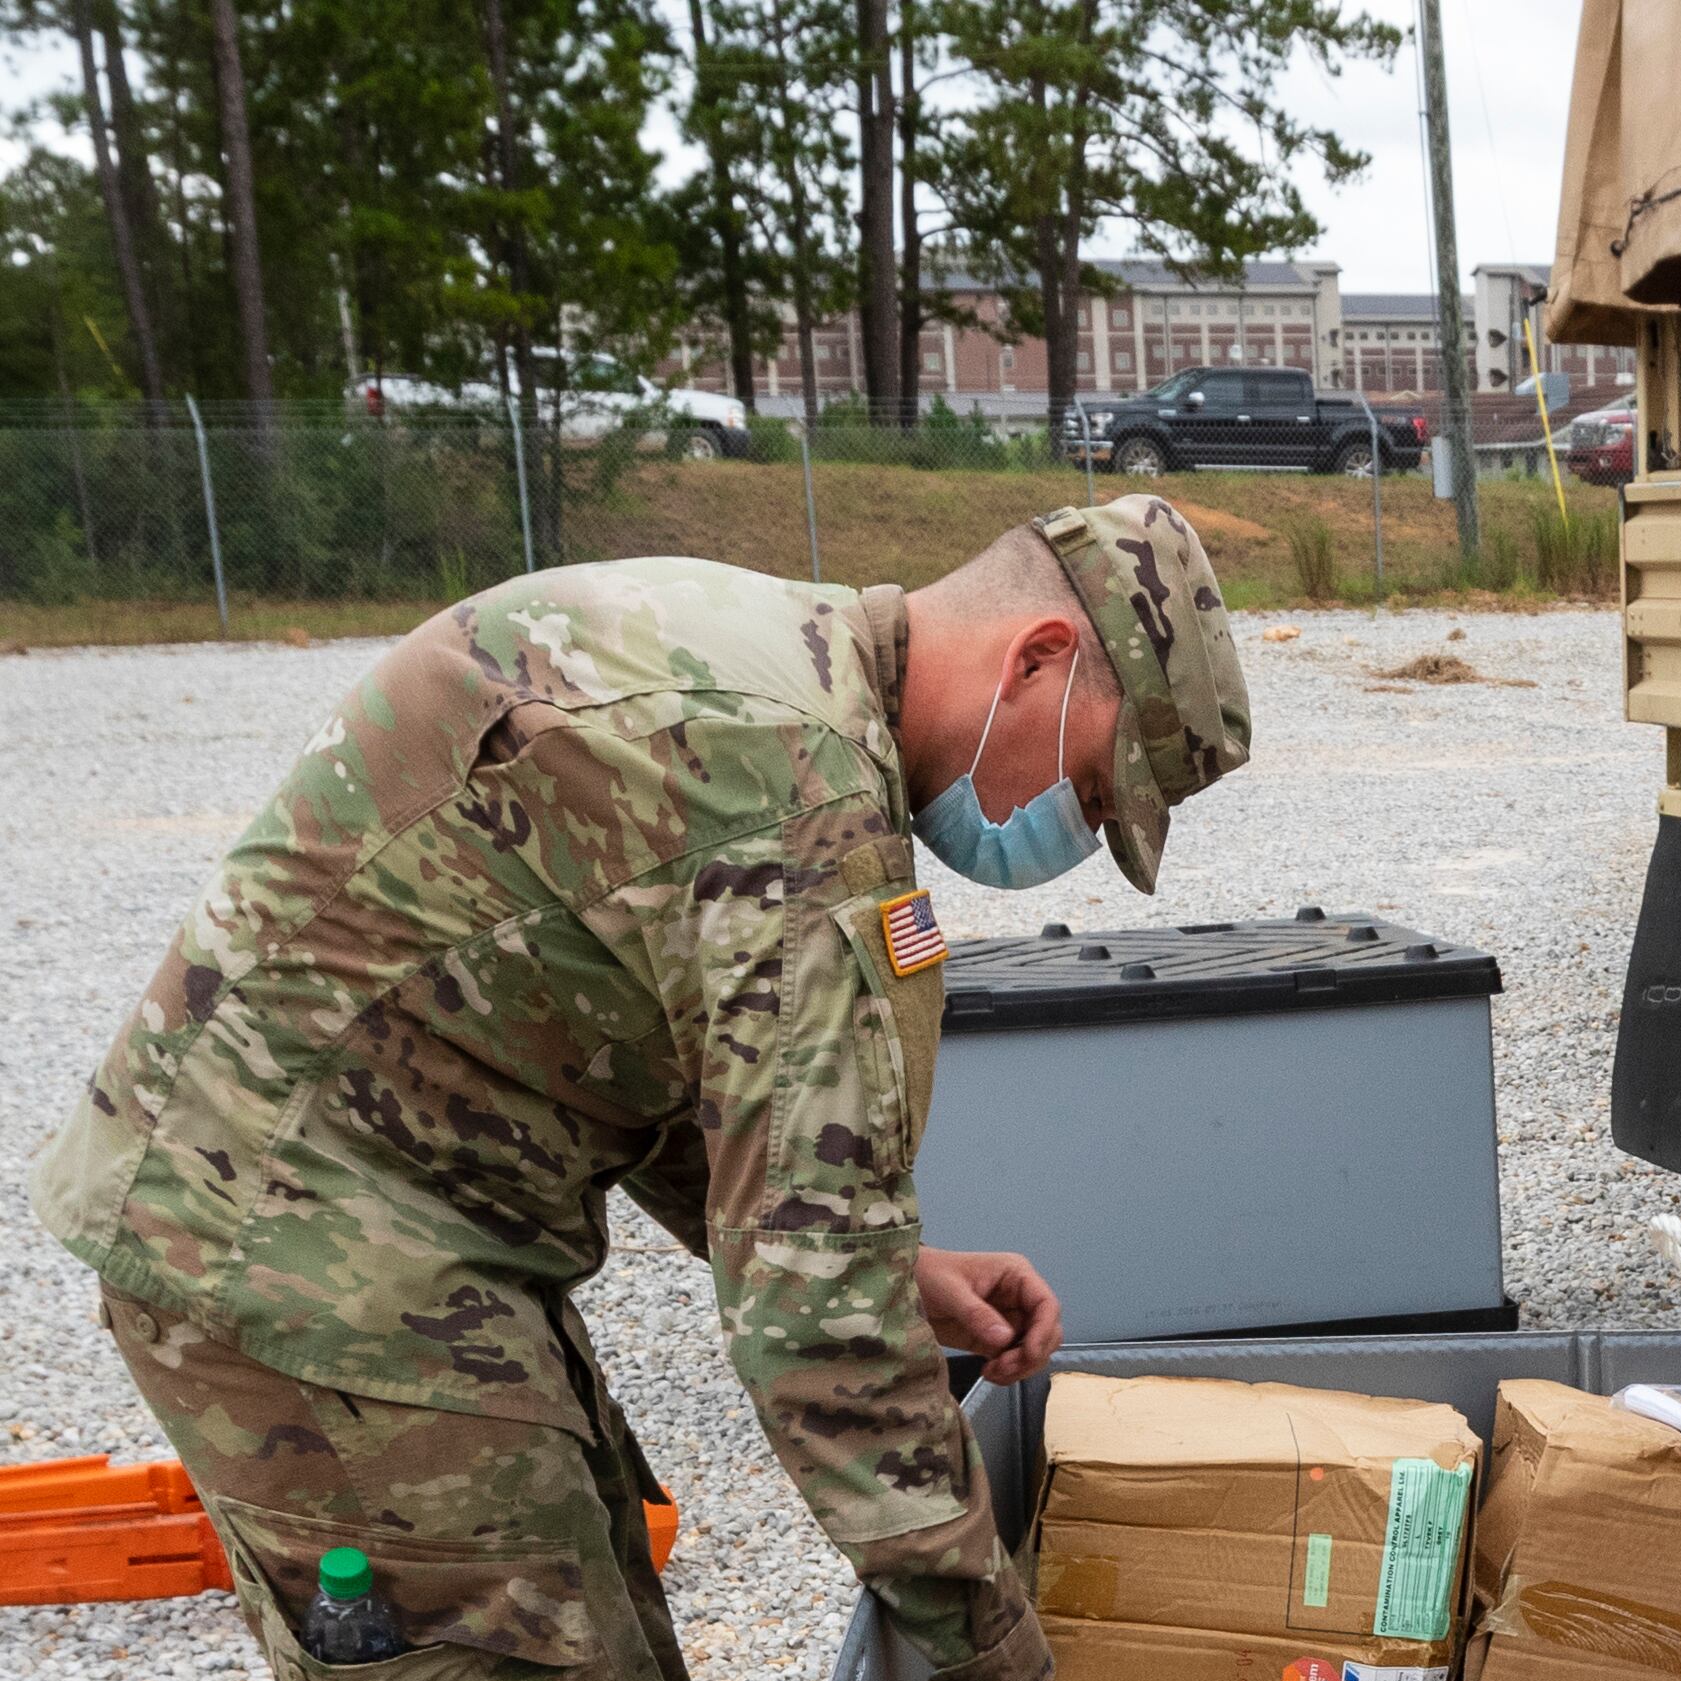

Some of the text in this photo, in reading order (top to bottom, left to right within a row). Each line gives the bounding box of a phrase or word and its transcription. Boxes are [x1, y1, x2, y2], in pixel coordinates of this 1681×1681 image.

[1392, 1486, 1405, 1523] APPAREL
[1387, 1524, 1401, 1562] CONTROL
[1377, 1563, 1396, 1632] CONTAMINATION
